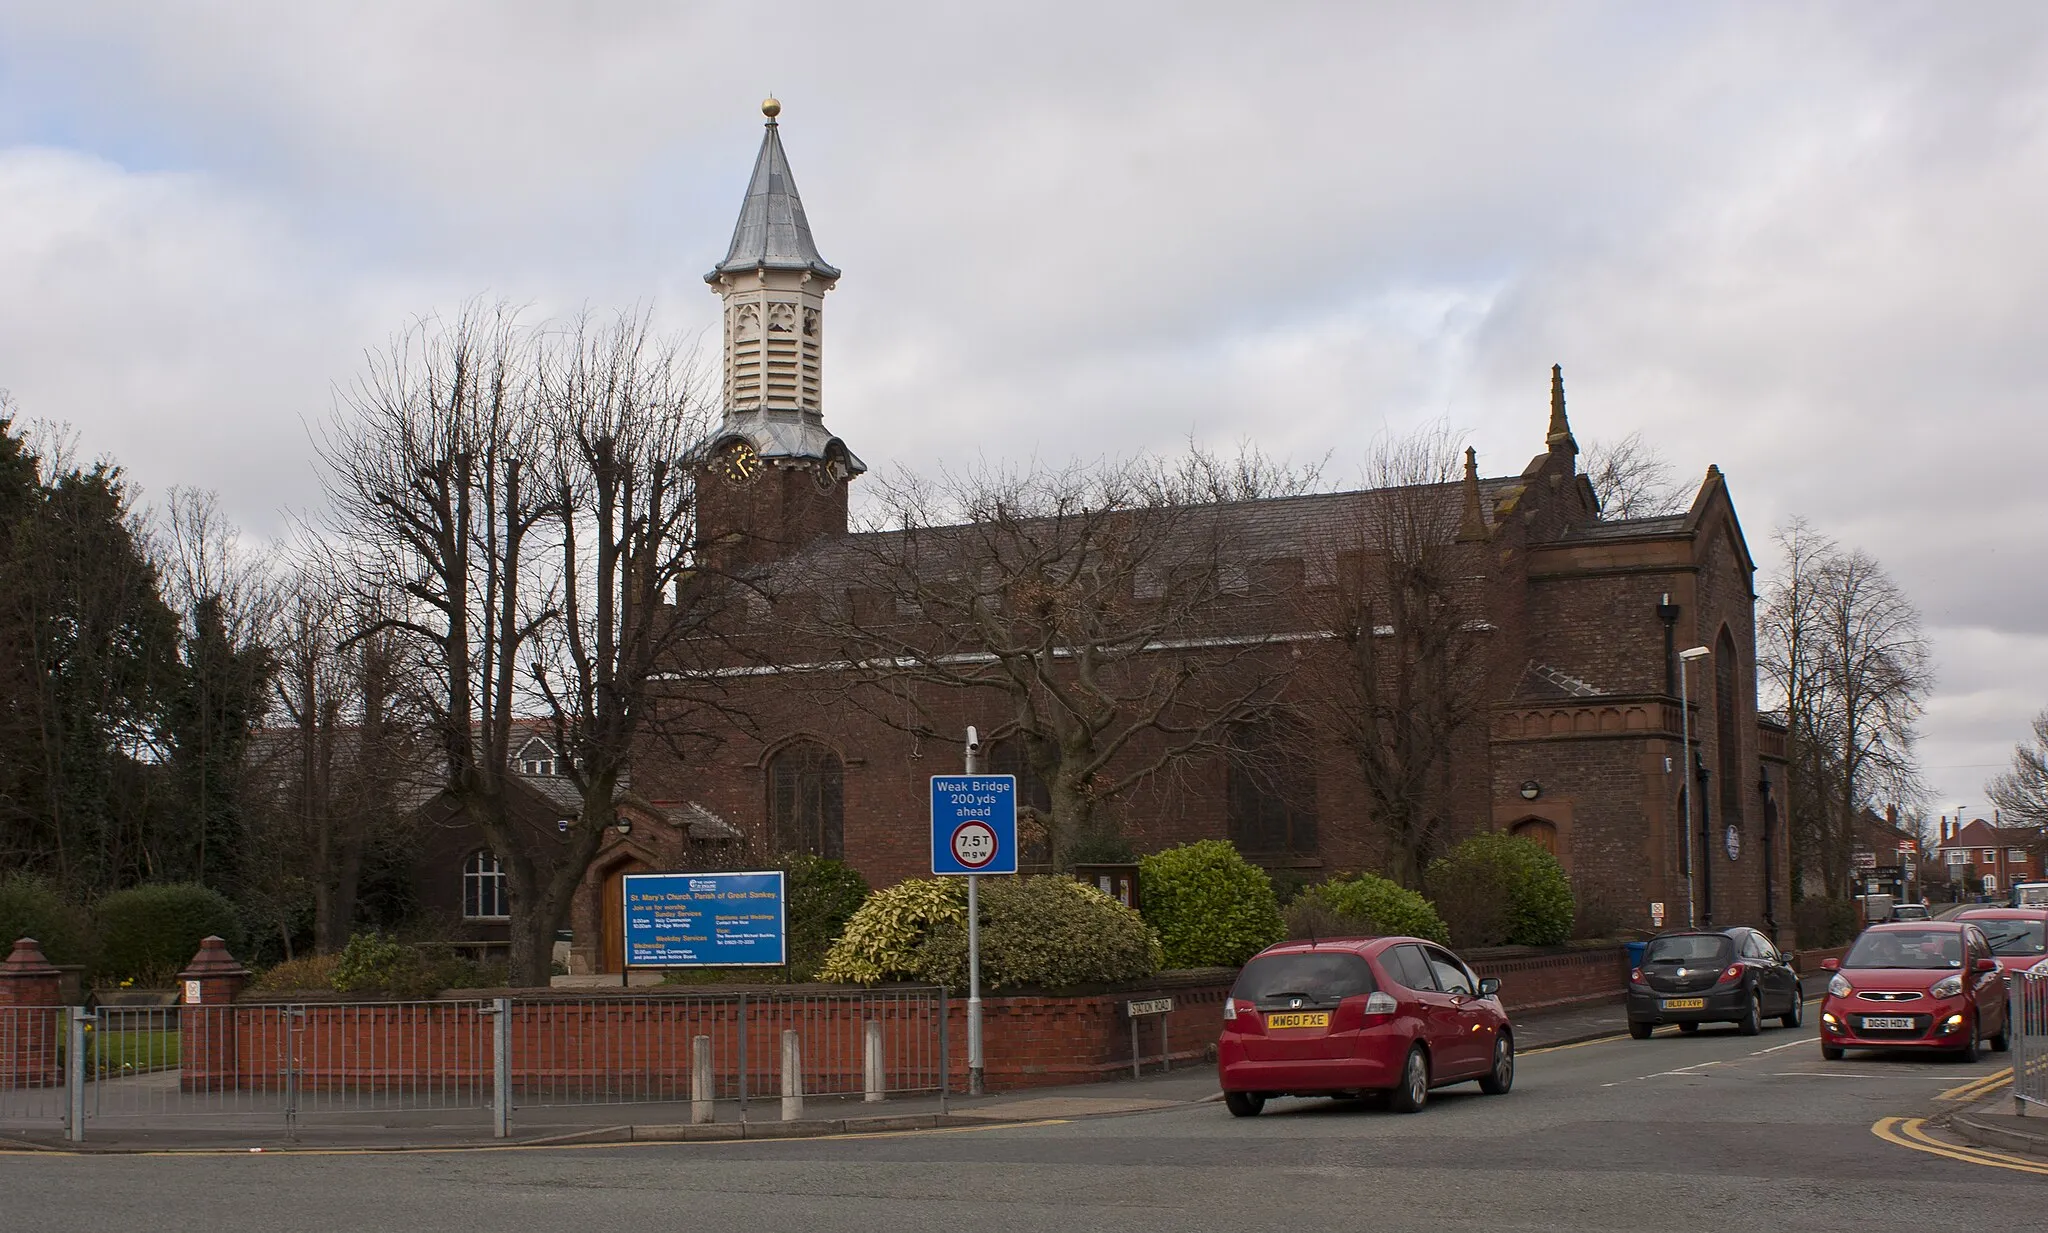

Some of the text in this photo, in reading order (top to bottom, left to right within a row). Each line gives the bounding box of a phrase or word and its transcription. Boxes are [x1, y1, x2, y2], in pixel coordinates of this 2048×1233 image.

[937, 781, 1010, 793] Weak Bridge
[951, 794, 996, 805] 200 yds
[956, 807, 991, 816] ahead
[642, 894, 664, 902] Mary's
[694, 892, 715, 900] Parish
[727, 891, 746, 899] Great
[1132, 999, 1170, 1015] STATION ROAD
[1302, 1014, 1324, 1025] FXE
